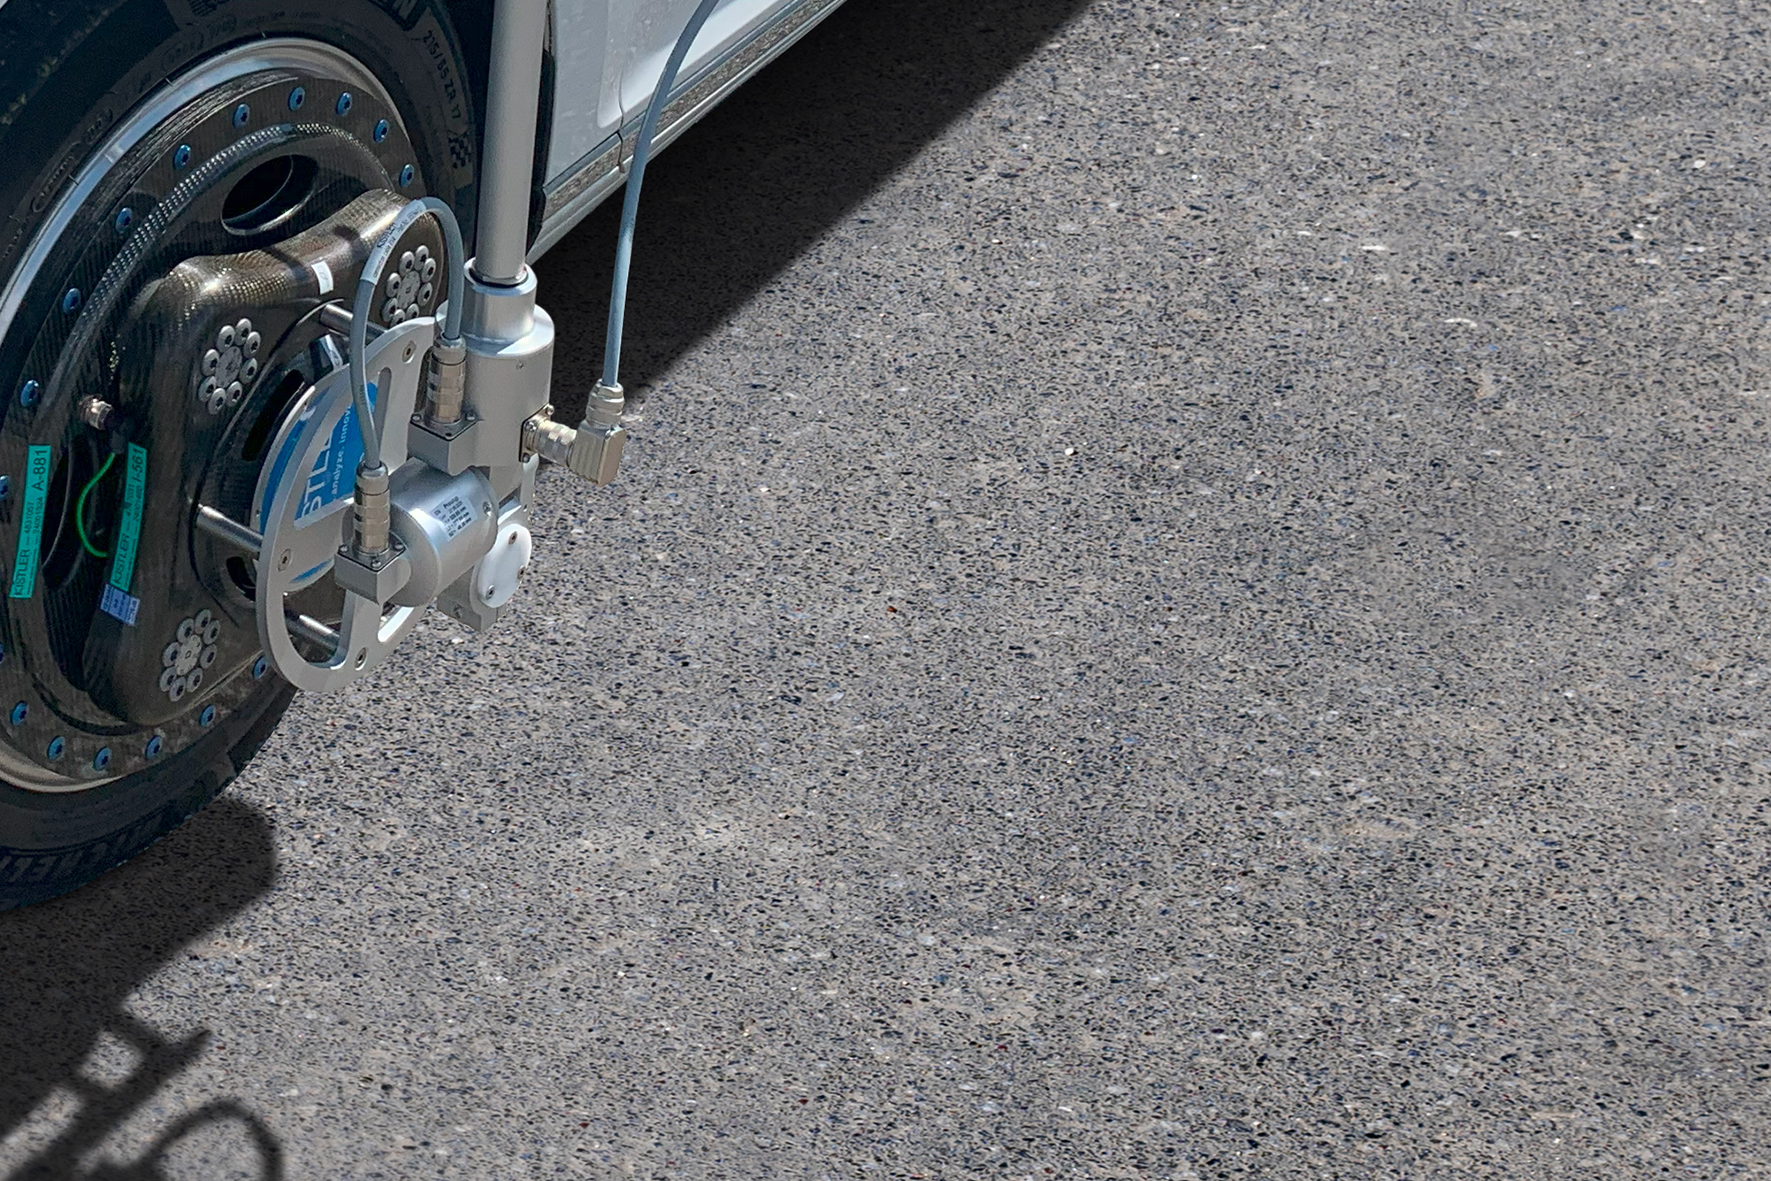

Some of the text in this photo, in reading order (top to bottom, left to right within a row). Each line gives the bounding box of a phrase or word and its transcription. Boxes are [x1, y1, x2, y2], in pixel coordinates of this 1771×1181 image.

[14, 548, 30, 595] KISTLER
[31, 449, 48, 491] A-881
[113, 532, 130, 585] KISTLER
